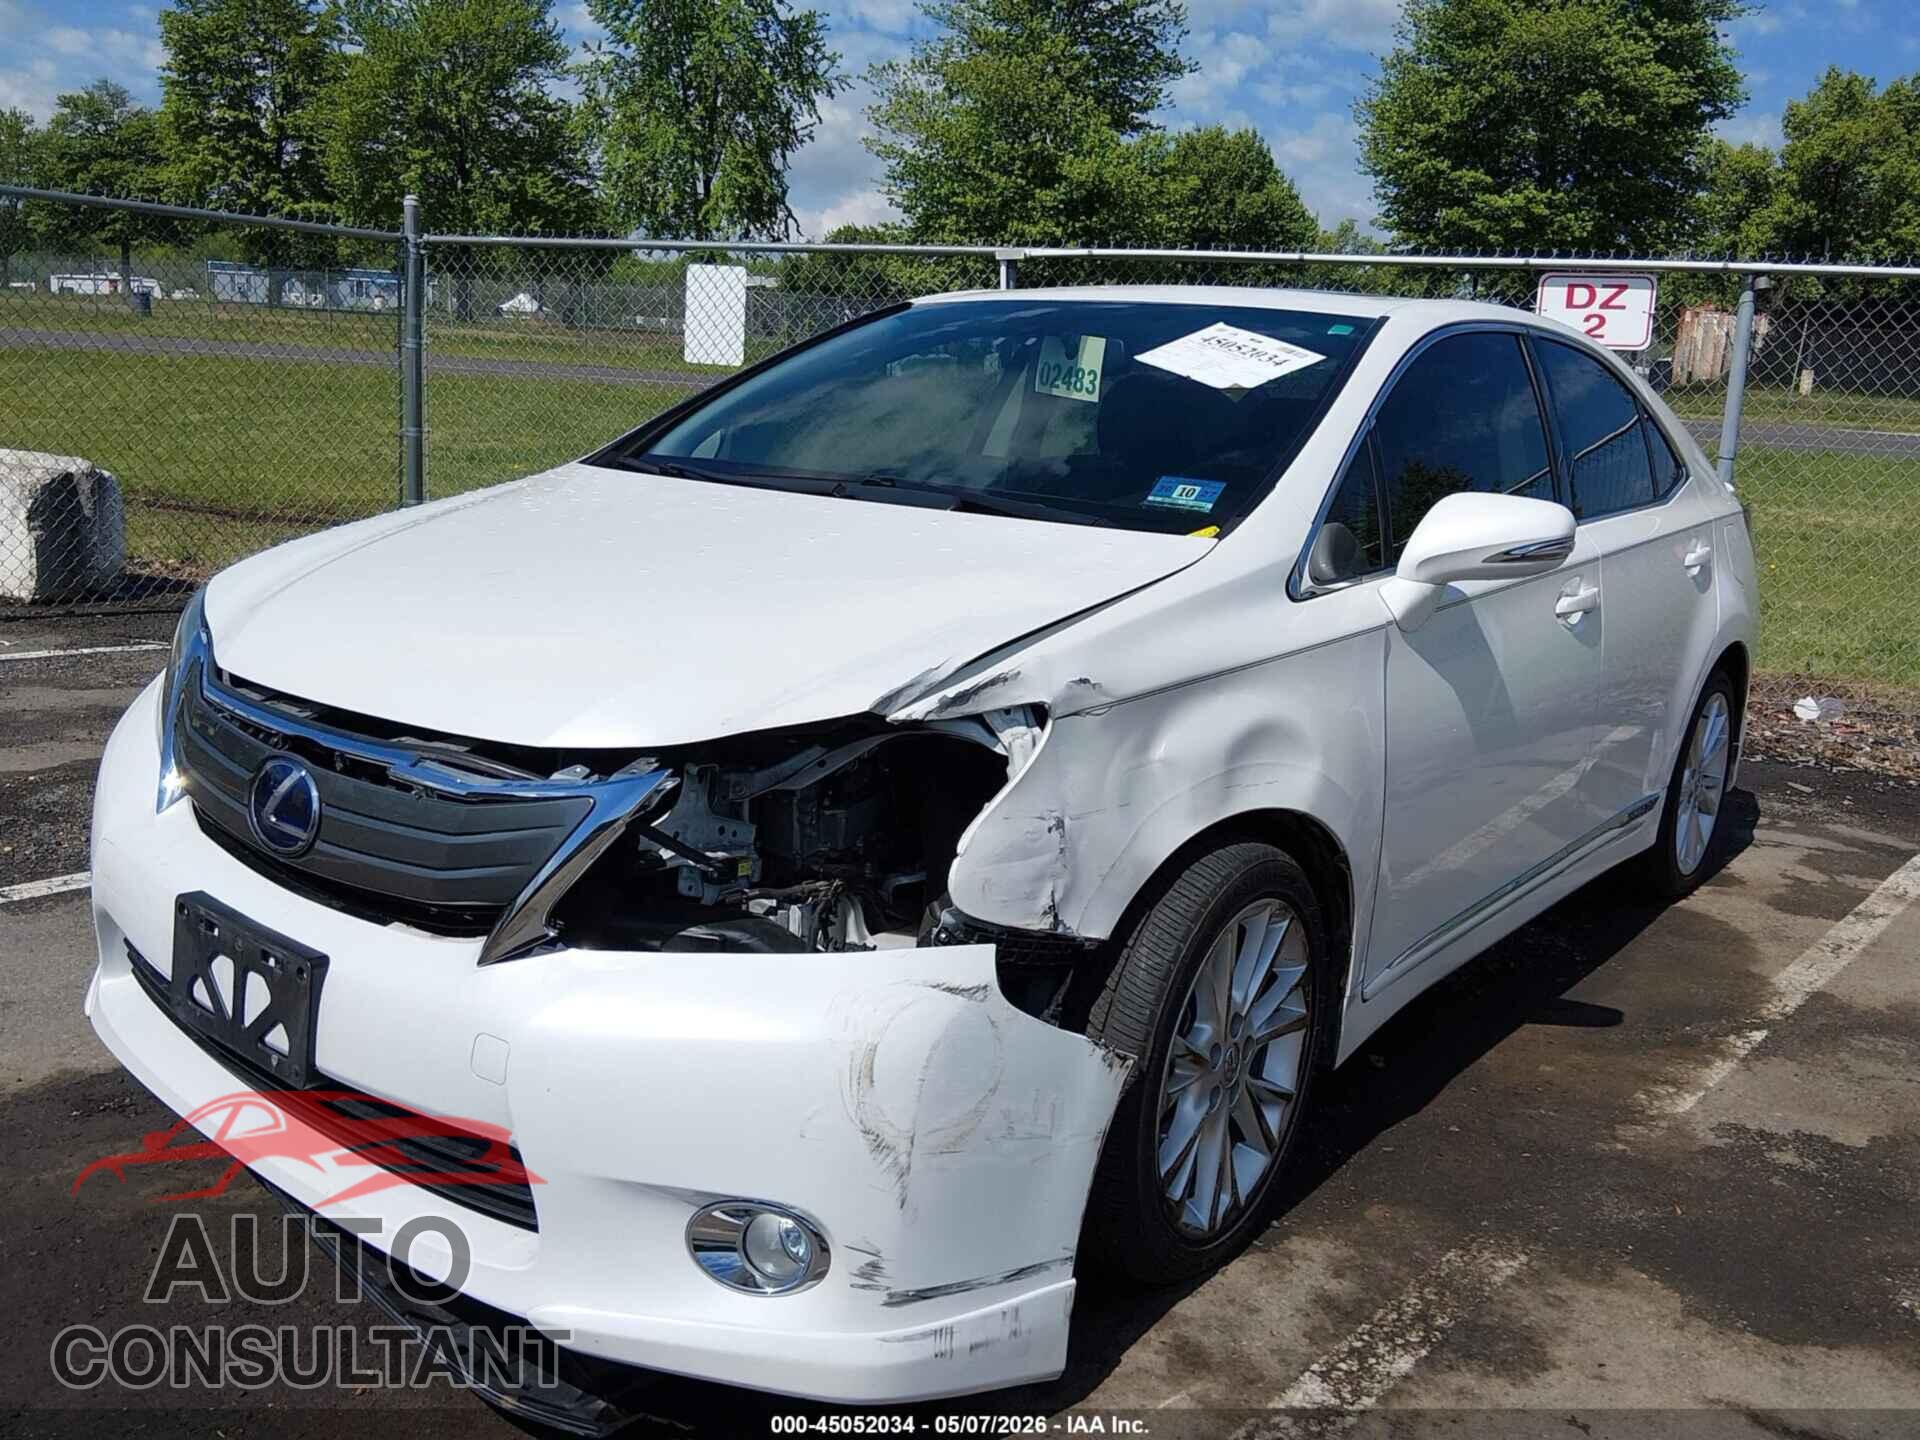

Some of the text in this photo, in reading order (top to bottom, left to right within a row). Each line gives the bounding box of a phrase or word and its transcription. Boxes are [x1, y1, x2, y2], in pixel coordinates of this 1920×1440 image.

[1565, 283, 1629, 310] DZ
[1583, 313, 1607, 338] 2
[1201, 335, 1292, 367] 45052034
[1040, 361, 1098, 395] 02483
[1178, 486, 1197, 499] 10
